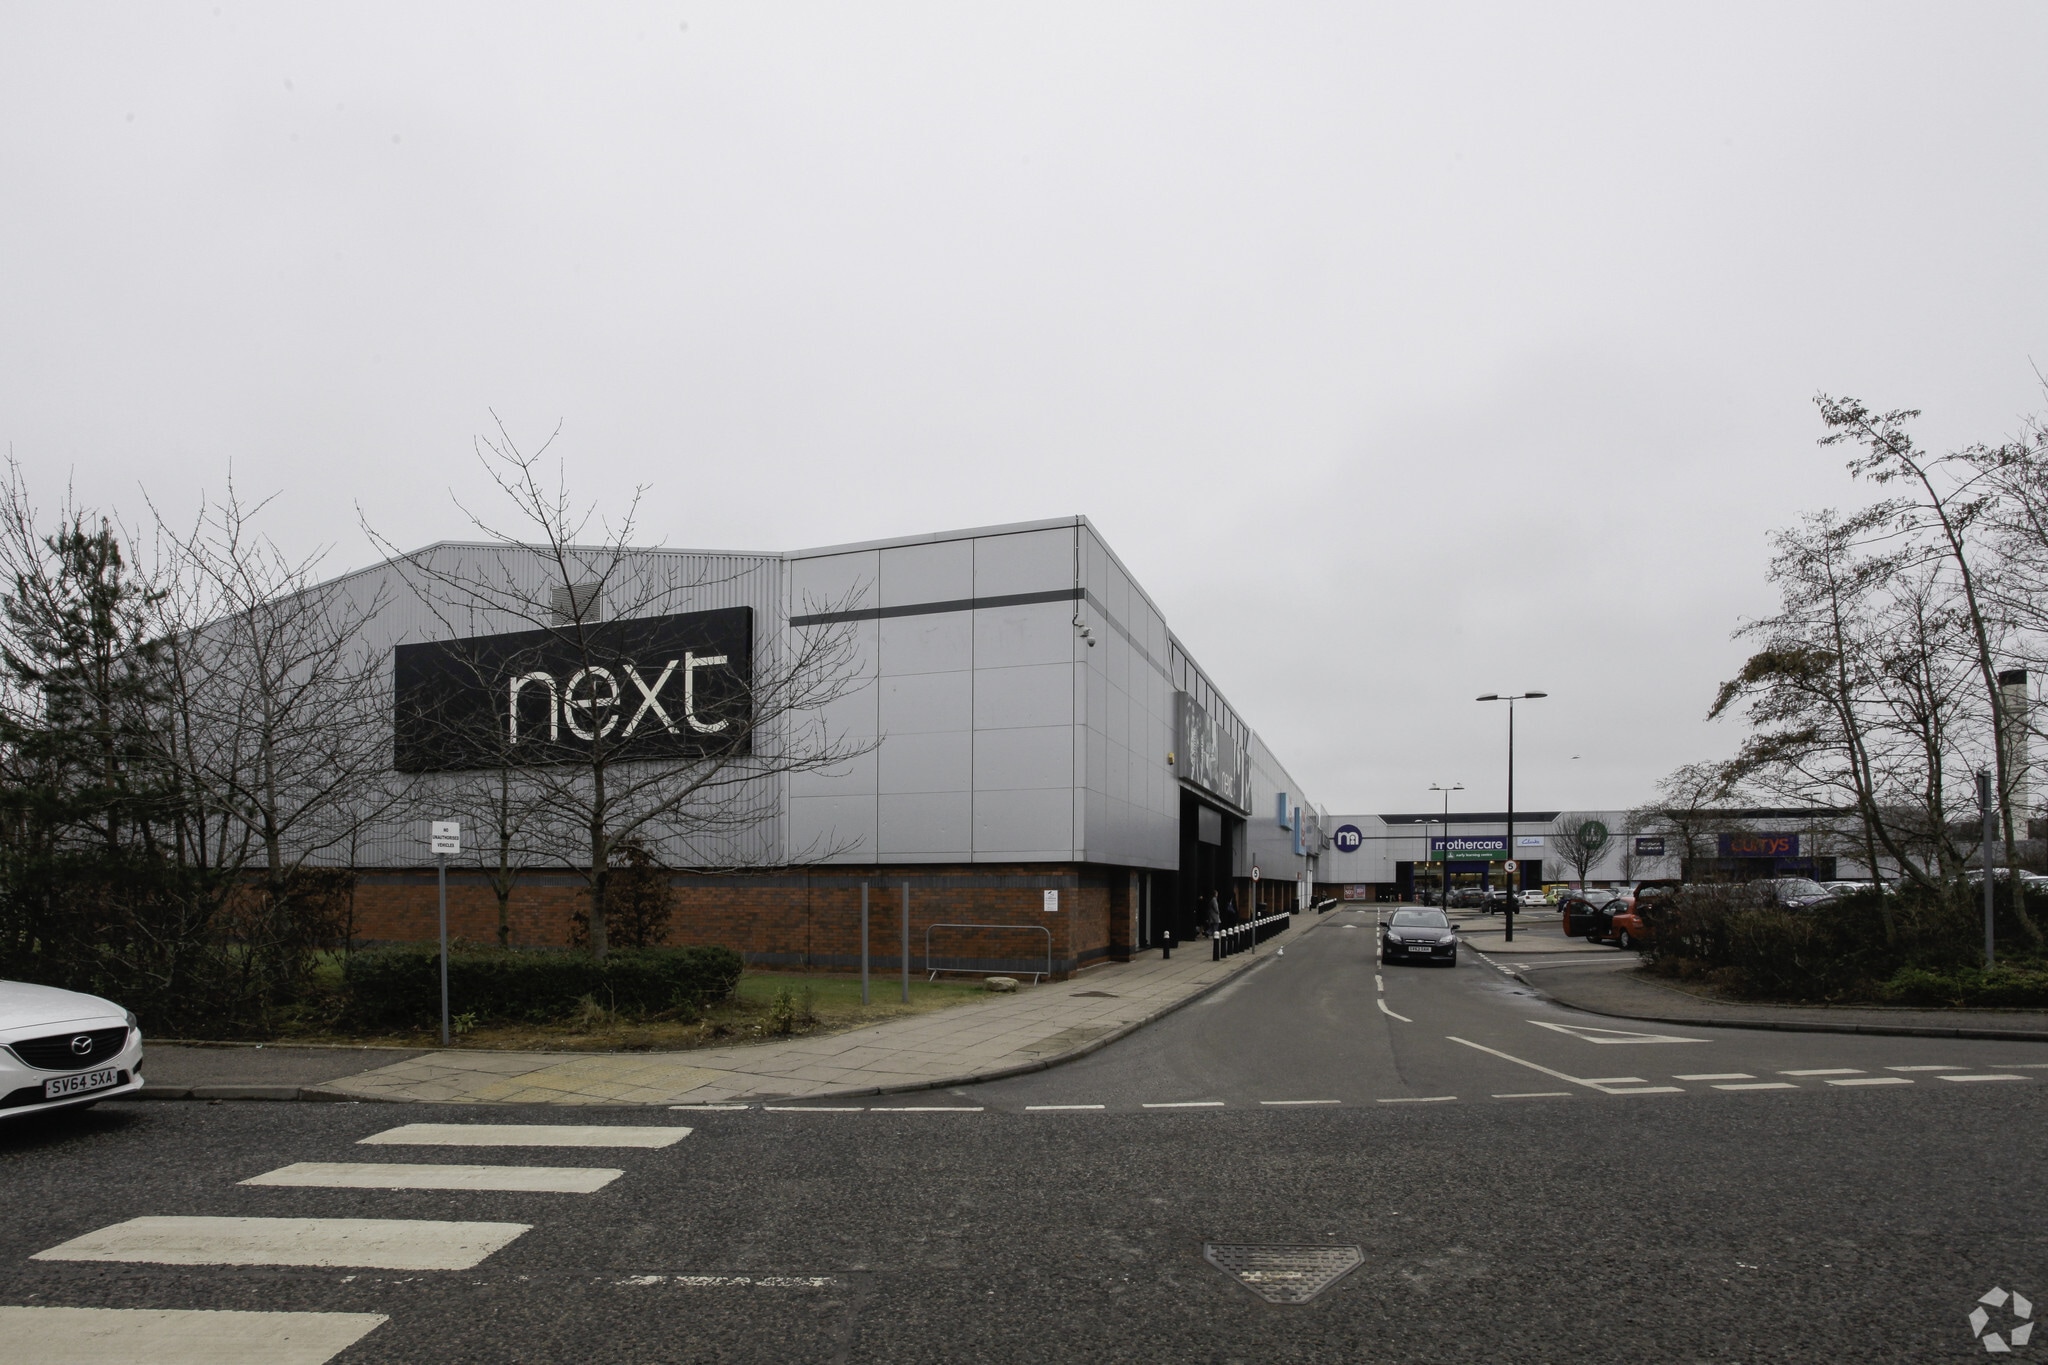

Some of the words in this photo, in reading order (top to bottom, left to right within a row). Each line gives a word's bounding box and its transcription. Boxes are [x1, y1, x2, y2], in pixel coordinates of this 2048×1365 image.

[509, 651, 729, 744] next
[1435, 838, 1503, 850] mothercare
[52, 1076, 86, 1093] SV64
[90, 1071, 112, 1086] SXA
